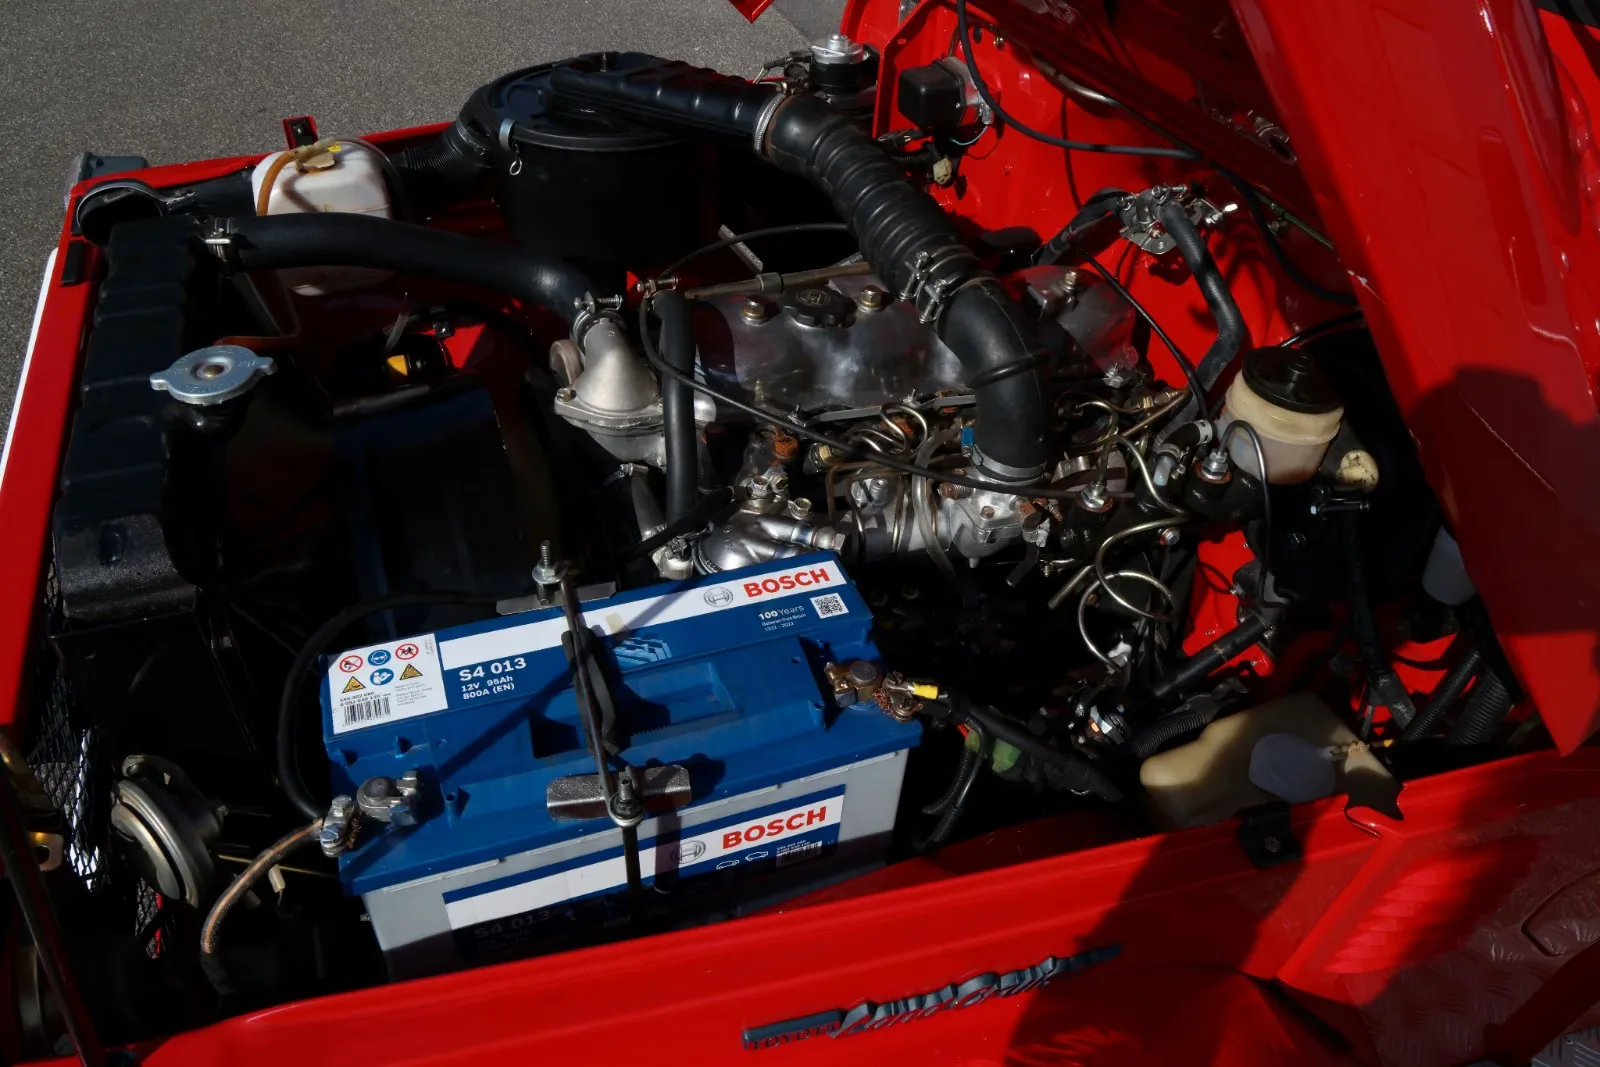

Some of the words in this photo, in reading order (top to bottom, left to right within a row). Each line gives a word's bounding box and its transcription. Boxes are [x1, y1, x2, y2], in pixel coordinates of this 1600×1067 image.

[743, 568, 831, 598] BOSCH
[758, 610, 778, 620] 100
[777, 605, 805, 615] Years
[458, 665, 486, 682] S4
[490, 657, 527, 674] 013
[461, 682, 480, 692] 12V
[486, 675, 513, 687] 95Ah
[462, 688, 490, 700] 800A
[492, 682, 515, 694] (EN)
[722, 805, 828, 850] BOSCH
[474, 922, 502, 938] S4
[511, 909, 552, 929] 013
[743, 1013, 844, 1052] TOYOTA
